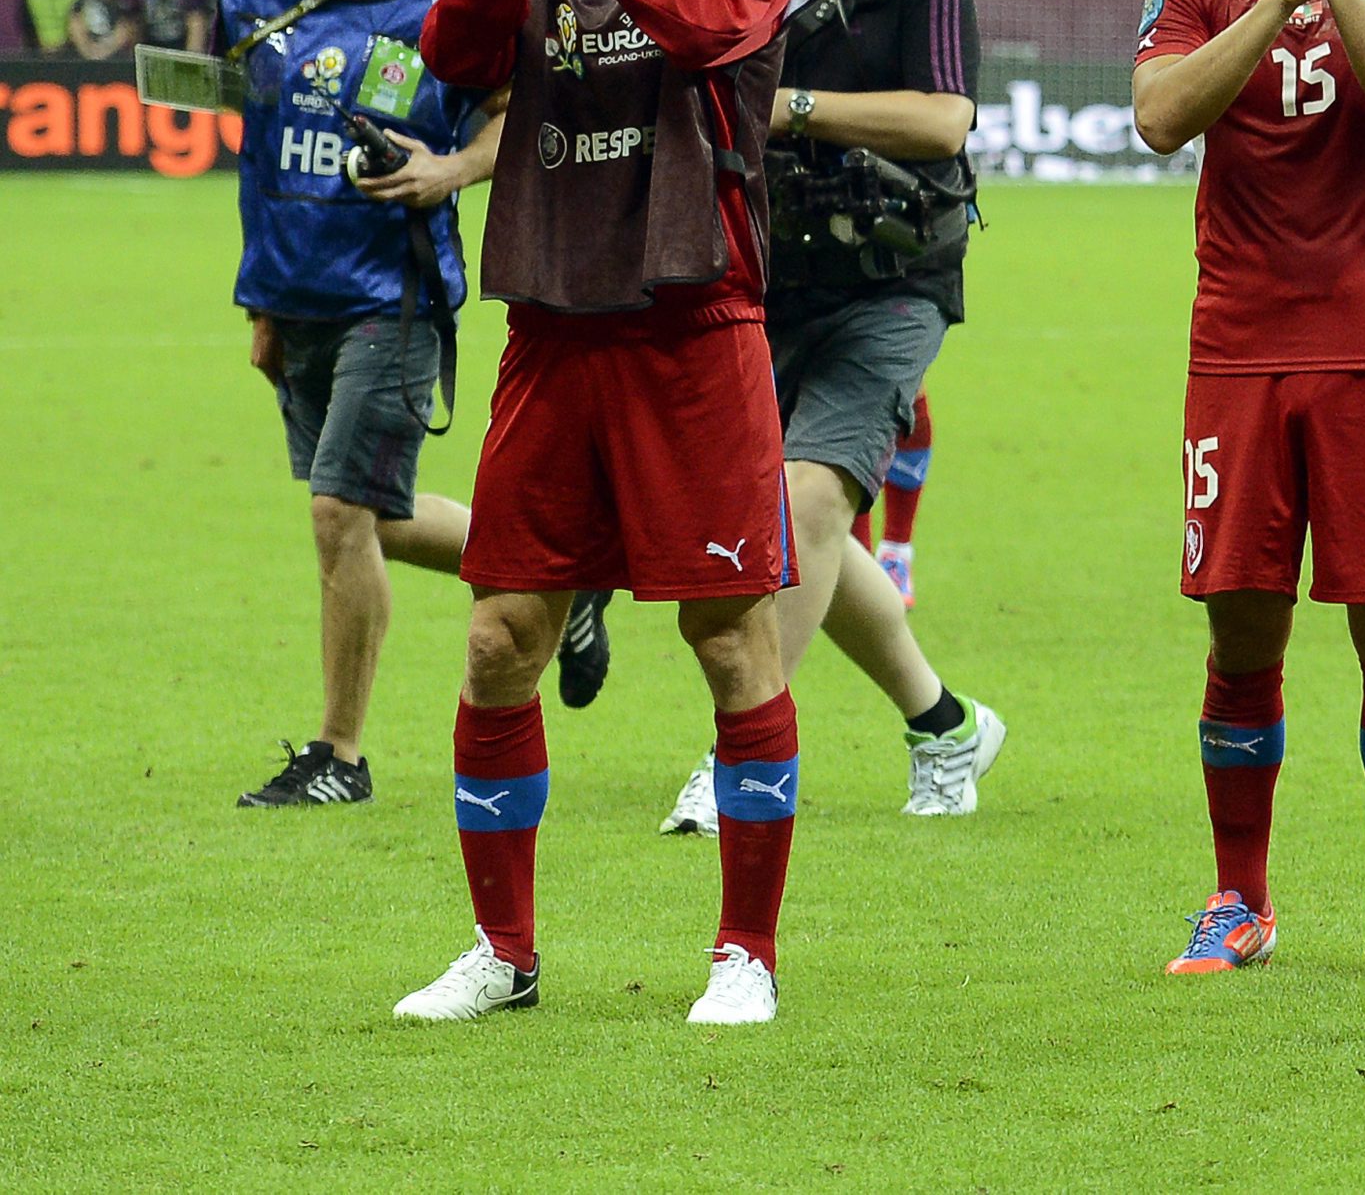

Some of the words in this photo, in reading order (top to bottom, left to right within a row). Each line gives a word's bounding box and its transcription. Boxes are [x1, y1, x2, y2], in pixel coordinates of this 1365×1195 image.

[581, 27, 656, 54] EURO
[598, 49, 664, 66] POLAND-UKR
[1271, 42, 1336, 117] 15
[280, 126, 348, 176] HB
[1184, 436, 1219, 510] 15
